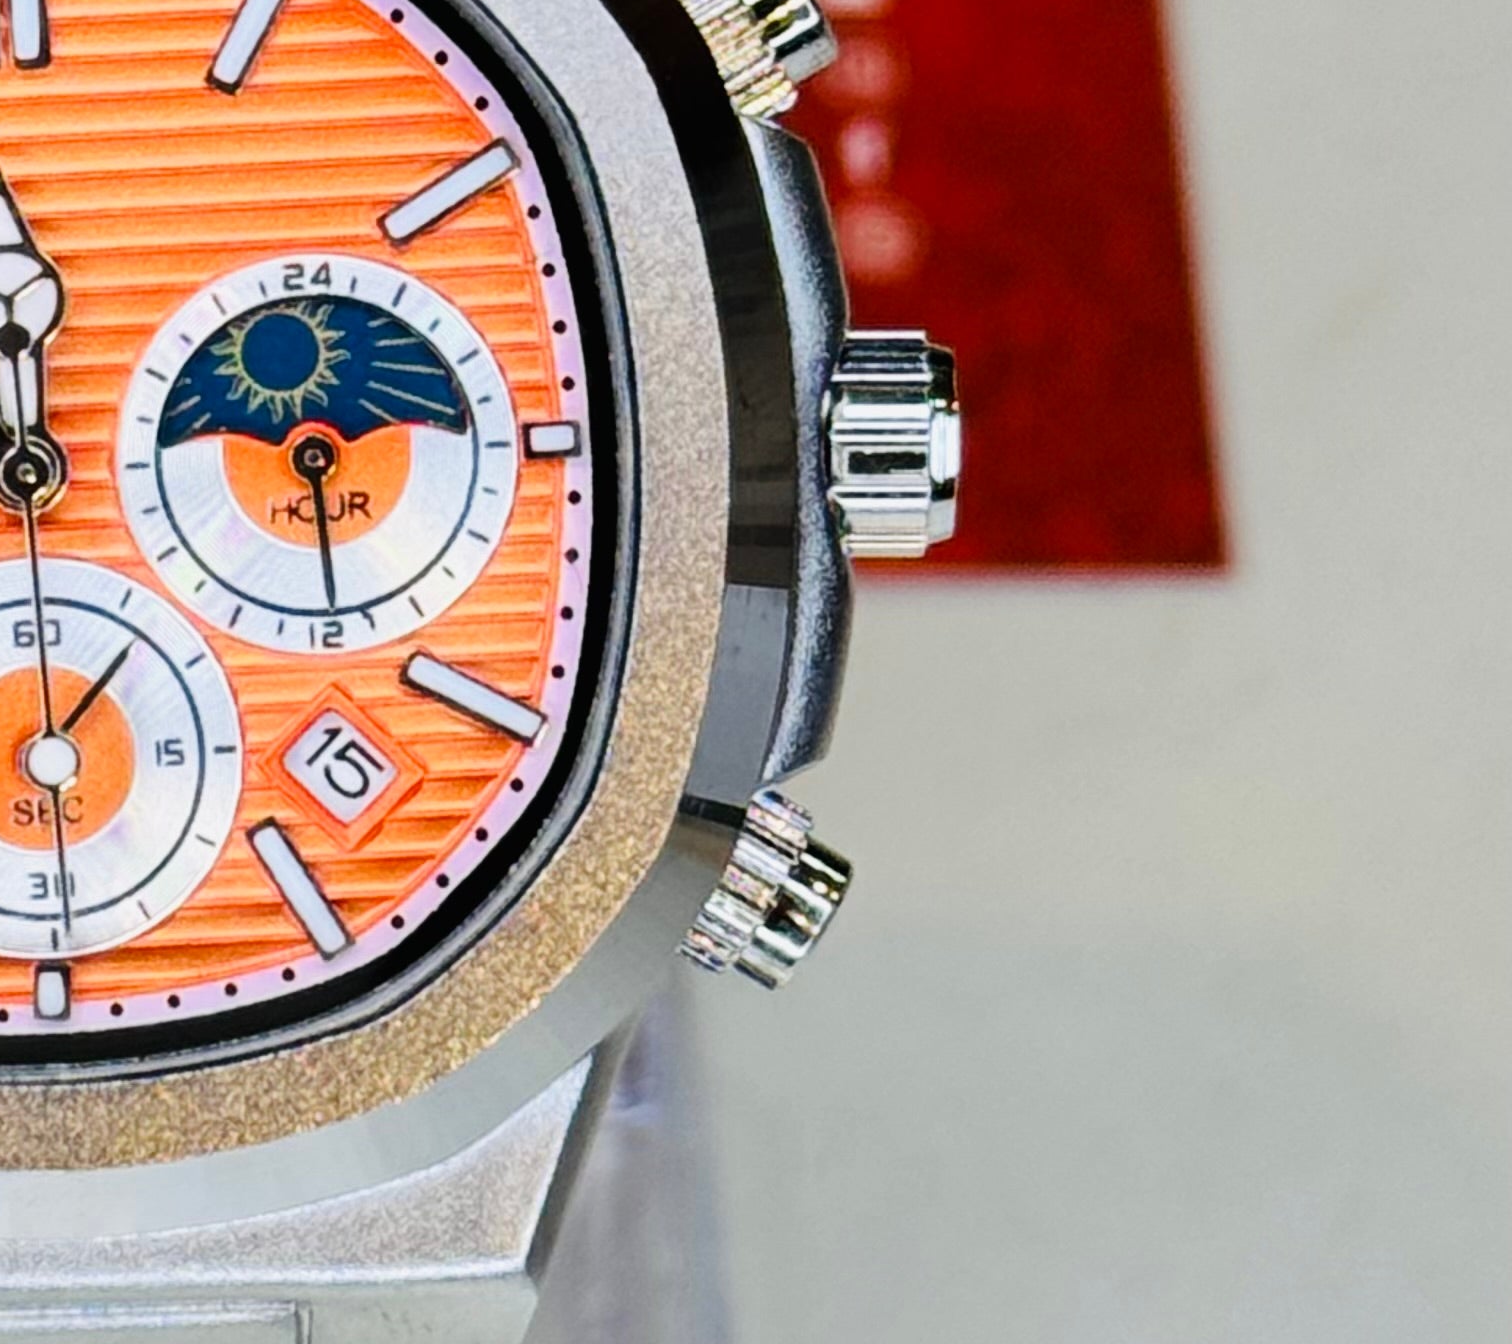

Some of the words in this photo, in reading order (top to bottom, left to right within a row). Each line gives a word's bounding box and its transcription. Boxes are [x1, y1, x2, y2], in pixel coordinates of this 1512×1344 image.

[282, 261, 333, 291] 24
[270, 491, 372, 524] HOUR
[13, 619, 61, 647] 60
[309, 620, 345, 648] 12
[155, 738, 186, 767] 15
[306, 726, 385, 799] 15
[13, 796, 83, 826] SEC
